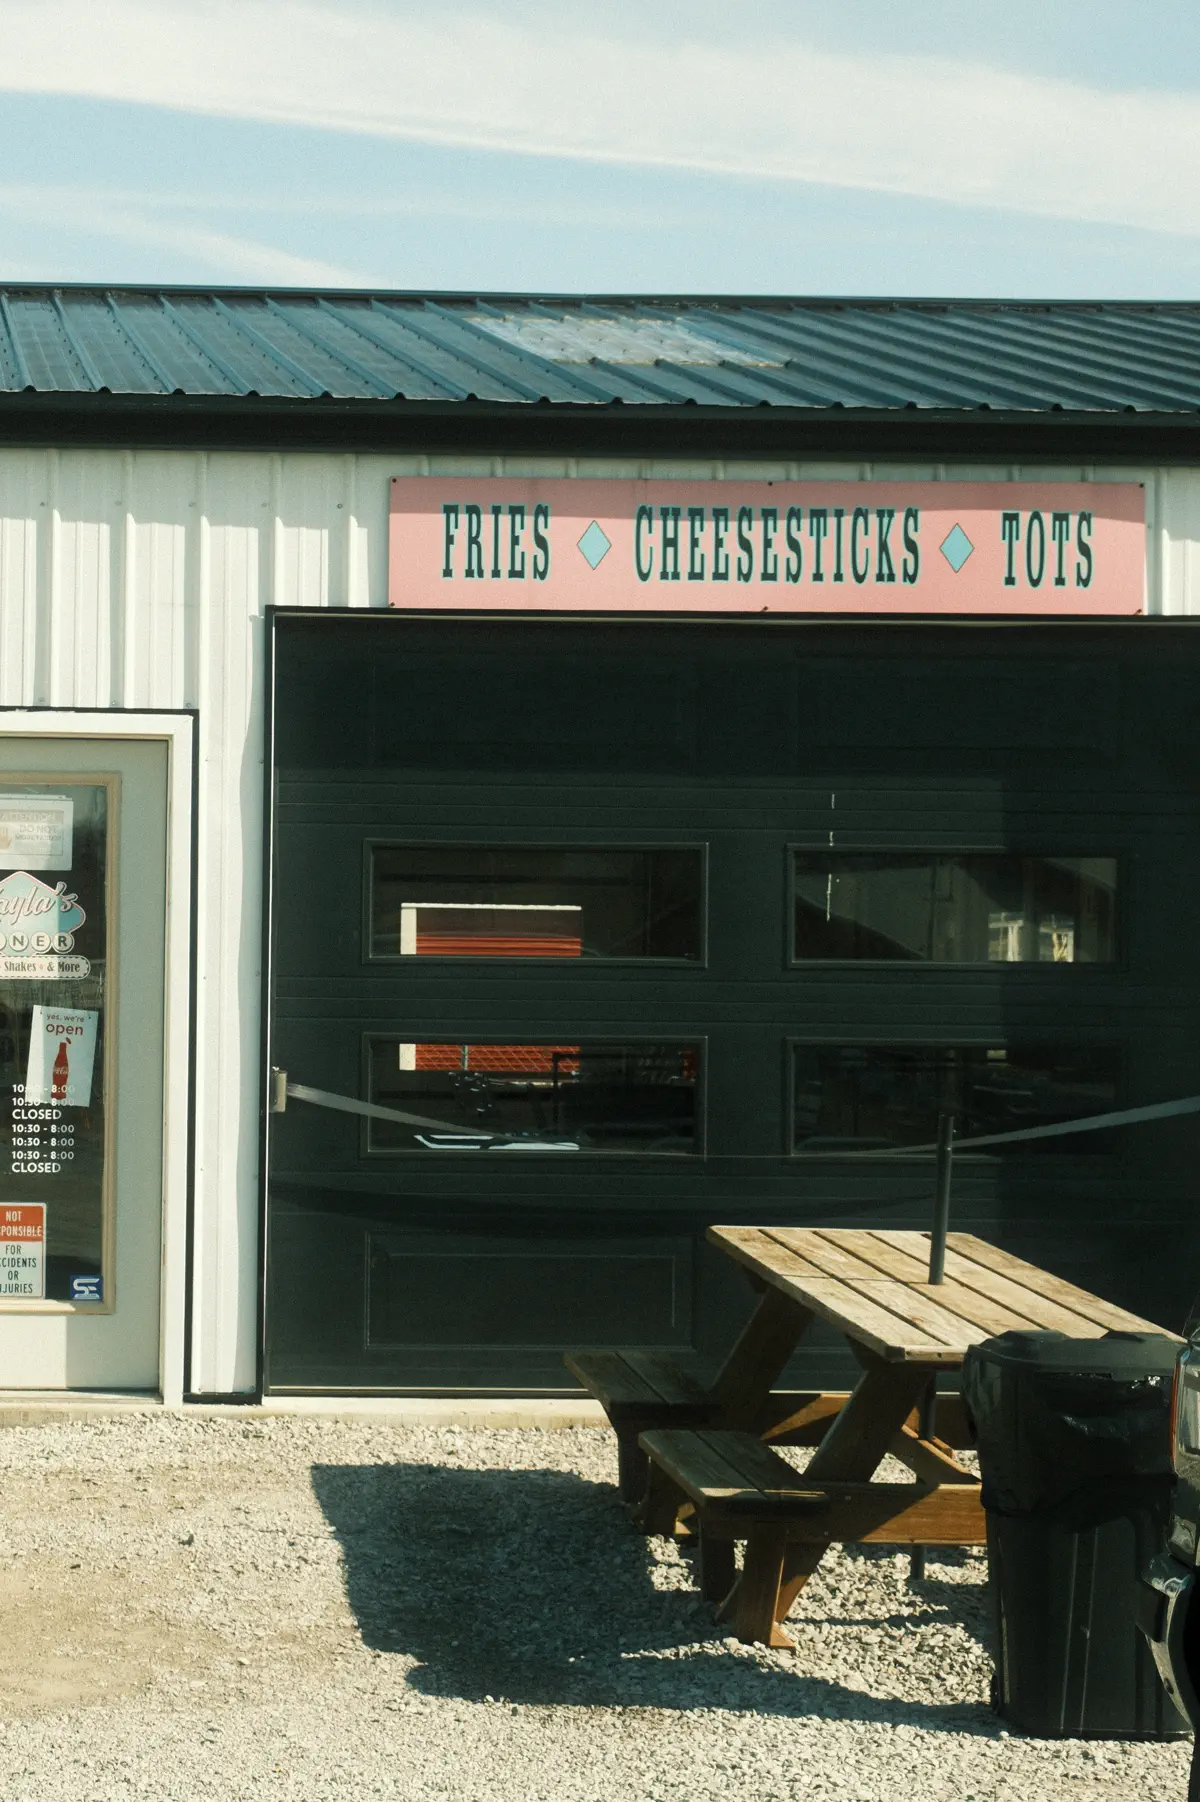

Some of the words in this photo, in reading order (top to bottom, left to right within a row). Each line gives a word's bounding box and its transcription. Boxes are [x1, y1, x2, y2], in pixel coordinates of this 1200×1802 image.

[442, 504, 550, 581] FRIES
[634, 505, 920, 585] CHEESESTICKS
[1002, 510, 1093, 588] TOTS
[4, 960, 37, 972] Shakes
[46, 962, 55, 971] &
[57, 961, 81, 973] More
[46, 1023, 84, 1036] open
[11, 1109, 62, 1120] CLOSED
[11, 1124, 40, 1133] 10:30
[50, 1124, 75, 1133] 8:00
[11, 1137, 40, 1146] 10:30
[50, 1137, 75, 1146] 8:00
[11, 1150, 40, 1159] 10:30
[50, 1151, 75, 1160] 8:00
[11, 1162, 61, 1173] CLOSED
[5, 1210, 22, 1222] NOT
[5, 1245, 22, 1255] FOR
[7, 1270, 19, 1281] OR
